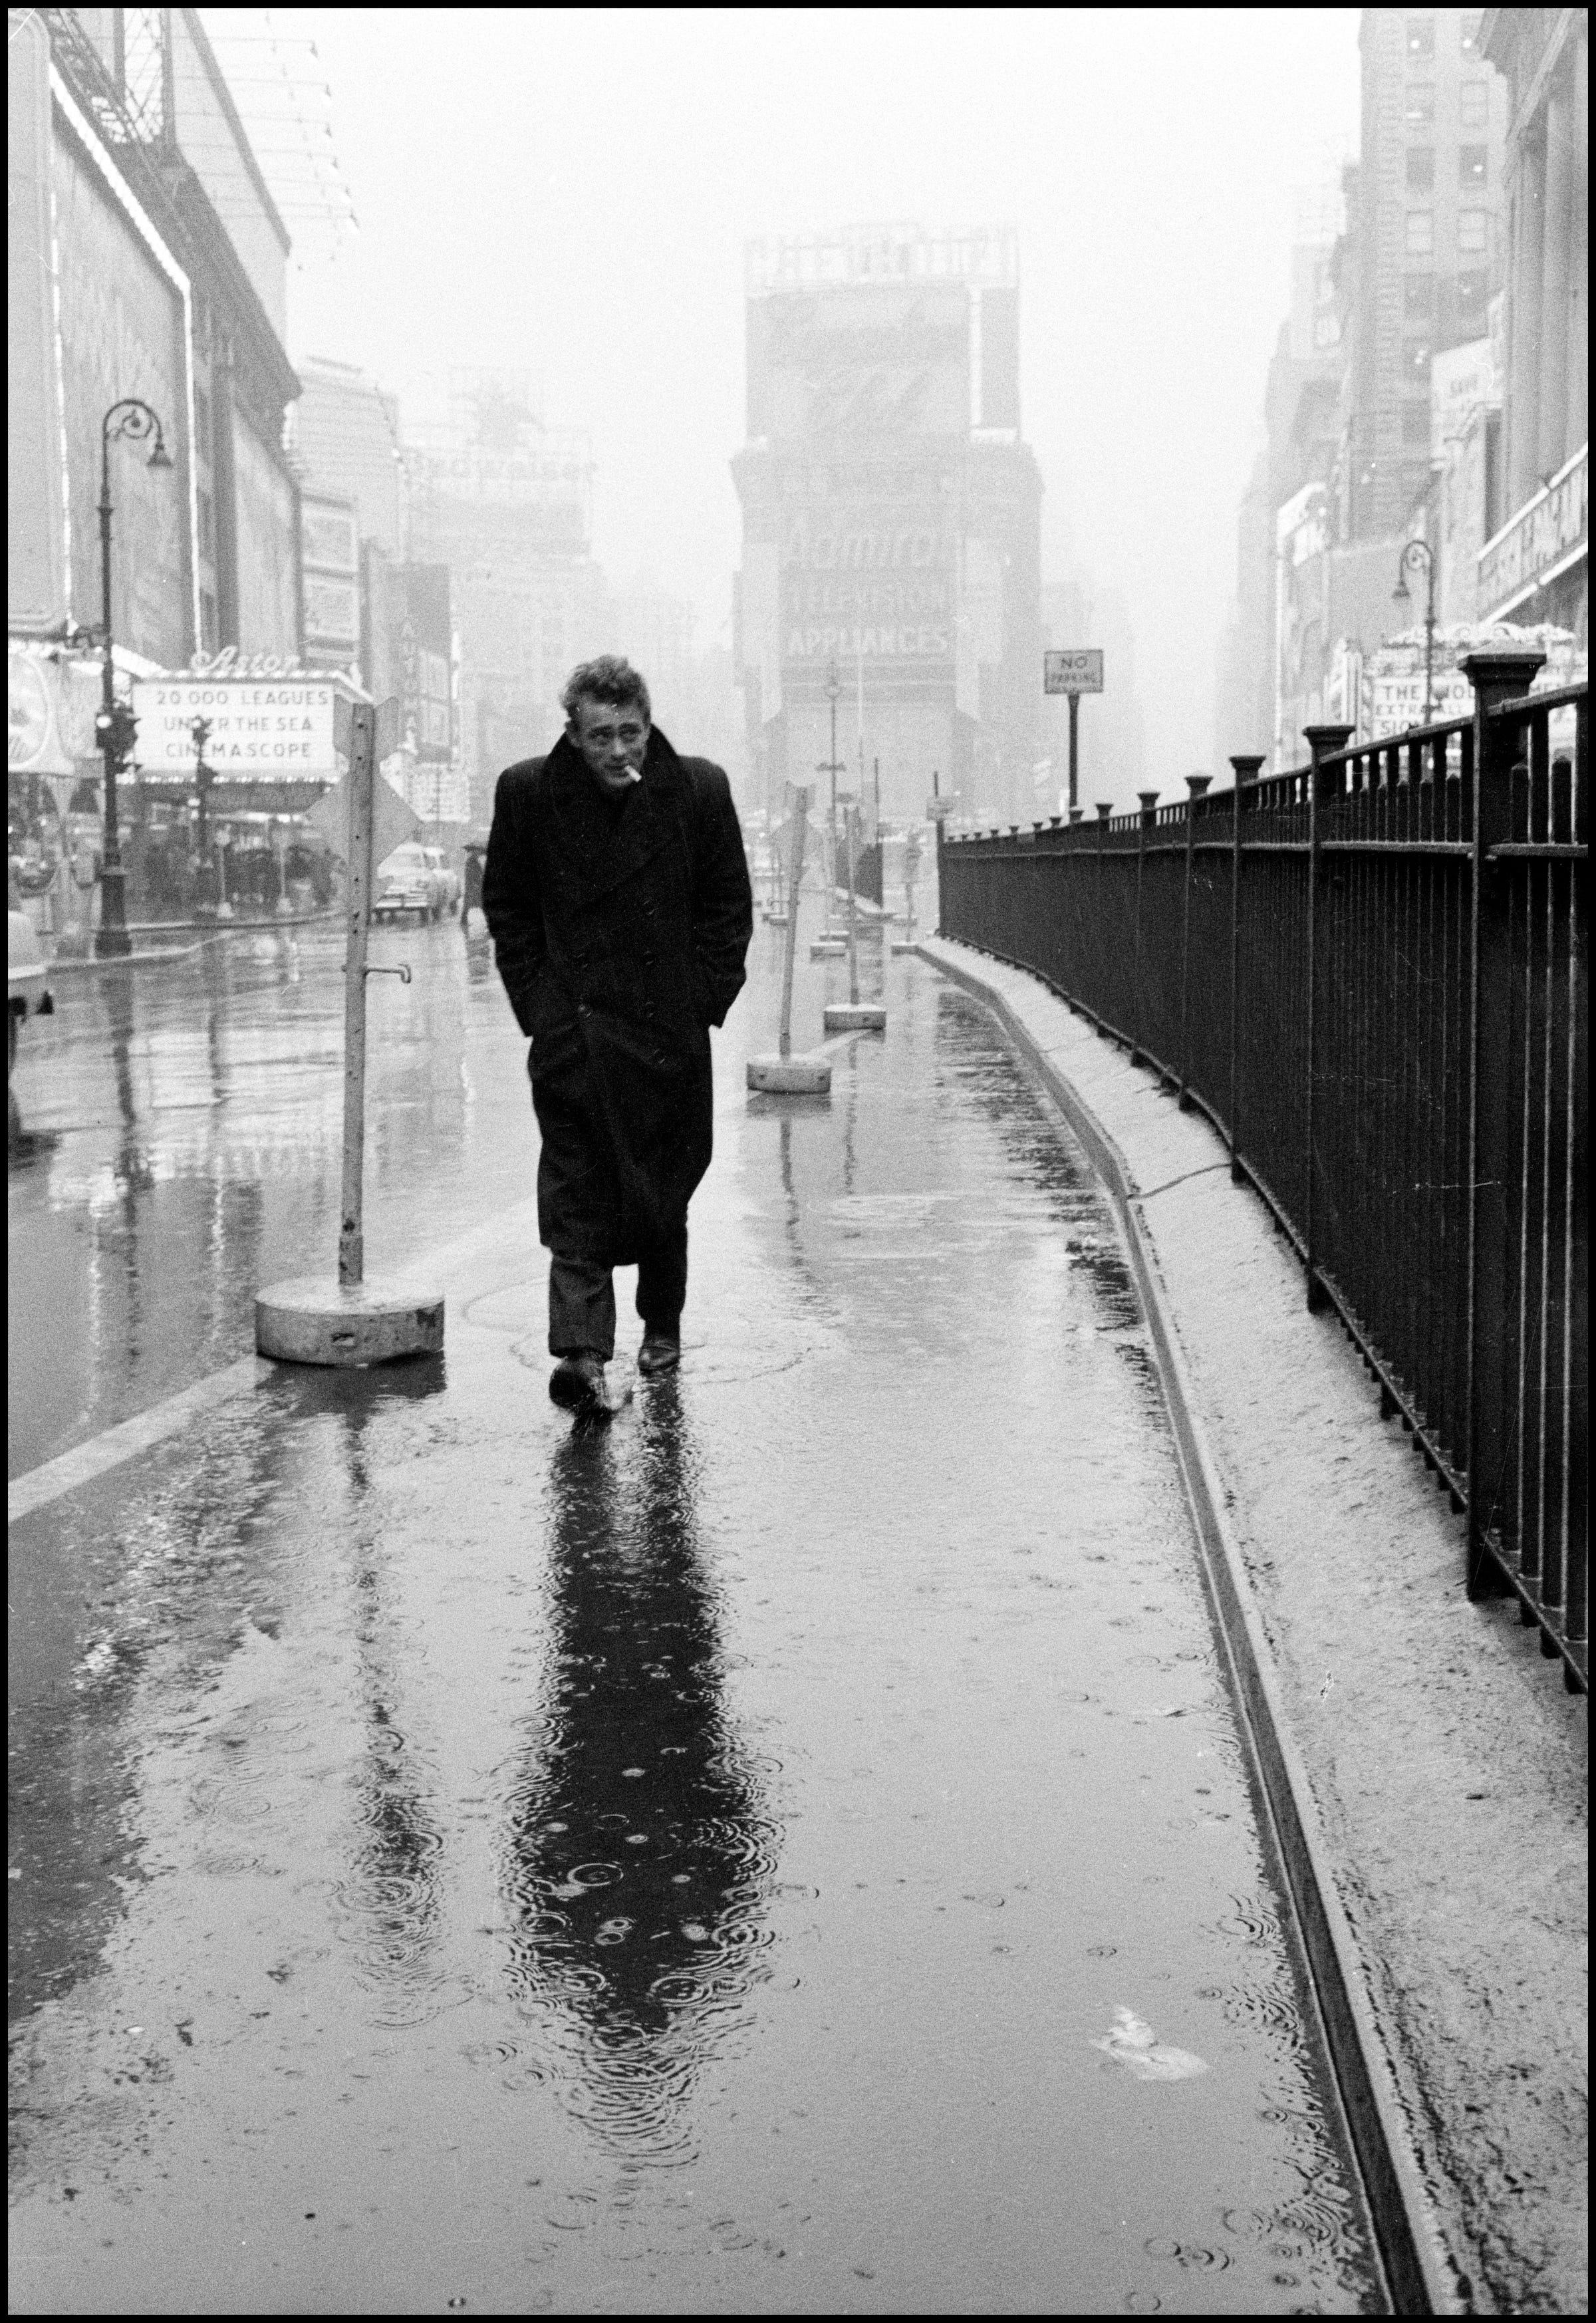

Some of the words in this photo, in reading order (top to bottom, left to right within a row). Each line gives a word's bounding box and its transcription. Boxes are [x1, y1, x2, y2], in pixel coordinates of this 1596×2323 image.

[787, 624, 949, 656] APPLIANCES
[190, 645, 301, 672] Astor
[1061, 656, 1087, 669] NO
[157, 690, 182, 705] 20
[189, 690, 228, 705] 000
[241, 690, 329, 705] LEAGUES
[1384, 685, 1420, 700] THE
[164, 717, 229, 731] UNR
[237, 717, 269, 731] THE
[278, 717, 313, 731] SEA
